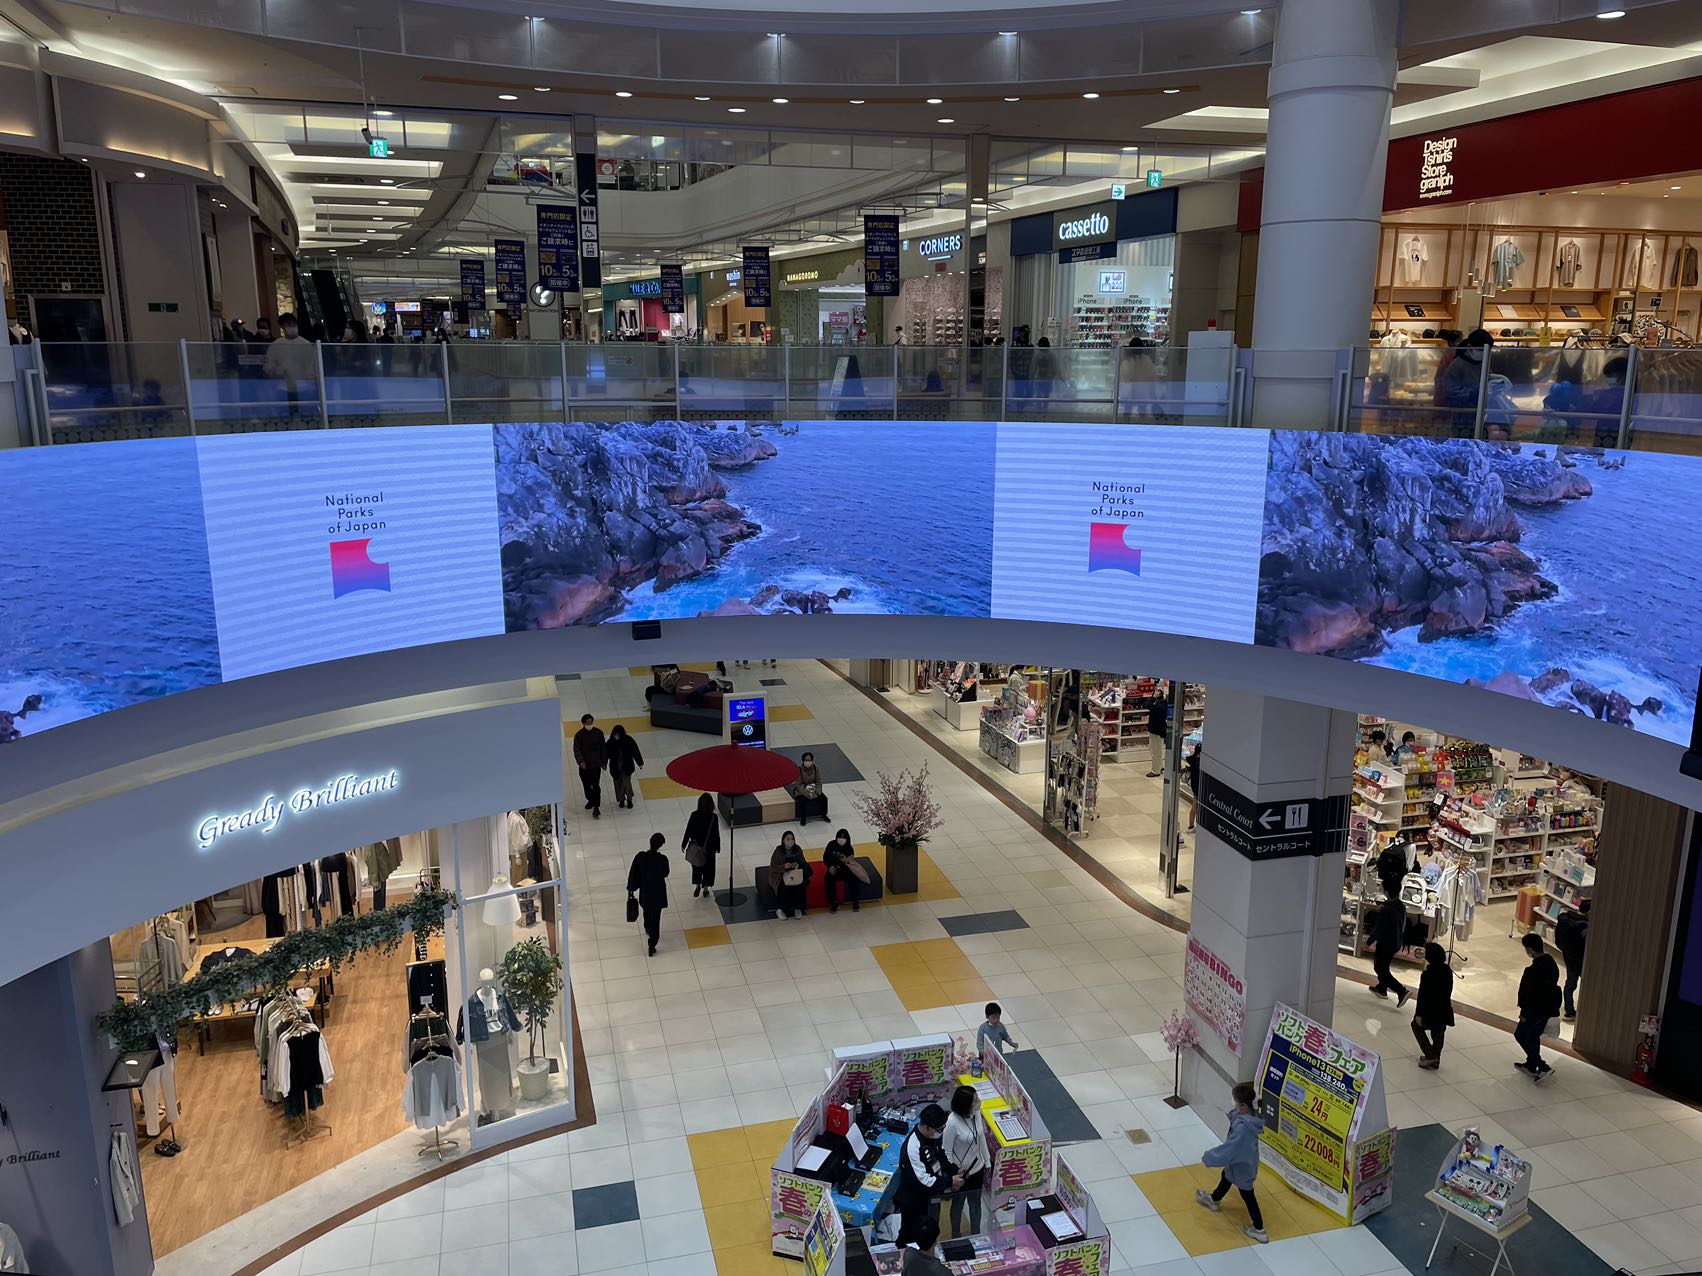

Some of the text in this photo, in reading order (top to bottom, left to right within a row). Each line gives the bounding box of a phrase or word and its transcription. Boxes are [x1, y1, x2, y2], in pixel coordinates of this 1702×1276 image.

[1424, 137, 1457, 153] Design
[1423, 151, 1452, 165] Tshirts
[1421, 165, 1446, 178] Store
[1420, 173, 1453, 192] graniph
[540, 212, 573, 220] 専門店限定
[1059, 212, 1109, 240] cassetto
[540, 238, 574, 246] ご請求時に
[919, 235, 961, 255] CORNERS
[1092, 481, 1145, 494] National
[325, 491, 384, 507] National
[1102, 494, 1134, 505] Parks
[338, 507, 374, 519] Parks
[1091, 506, 1144, 519] of Japan
[328, 521, 386, 534] of Japan
[197, 769, 398, 849] Gready Brilliant
[1208, 793, 1253, 829] Central Court
[1217, 824, 1252, 851] セントラルコート
[1255, 840, 1311, 853] セントラルコート
[1210, 955, 1243, 996] BINGO
[1280, 1010, 1305, 1032] ソフト
[1277, 1023, 1303, 1044] バンク
[903, 1048, 944, 1060] ソフトバンク
[1327, 1045, 1366, 1075] フェア
[847, 1057, 887, 1071] ソフトバンク
[935, 1055, 945, 1083] フェア
[879, 1065, 888, 1090] フェア
[7, 1150, 61, 1165] Brilliant
[1001, 1145, 1043, 1158] ソフトバンク
[999, 1157, 1032, 1187] 春の
[1034, 1153, 1043, 1181] フェア
[779, 1175, 823, 1193] ソフトバンク
[778, 1185, 812, 1217] 春の
[1054, 1243, 1101, 1260] ソフトバンク
